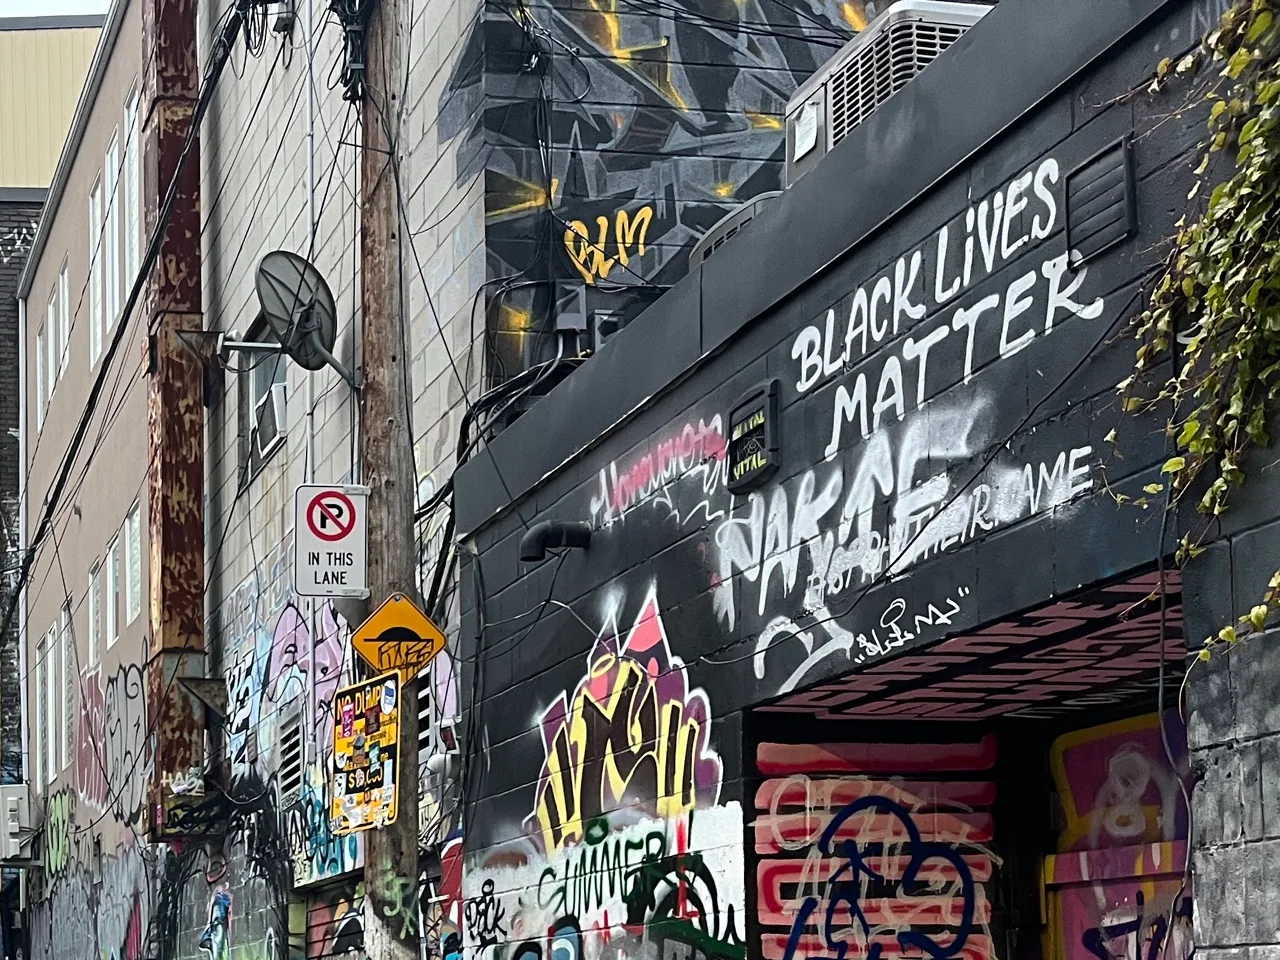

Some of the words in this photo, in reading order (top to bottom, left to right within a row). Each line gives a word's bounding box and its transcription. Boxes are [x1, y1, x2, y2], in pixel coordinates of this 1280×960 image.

[564, 206, 653, 285] BLM
[792, 250, 925, 393] BLACK
[826, 246, 1104, 462] MATTER
[733, 450, 767, 481] VITAL
[308, 552, 320, 566] IN
[326, 552, 354, 566] THIS
[314, 571, 348, 584] LANE
